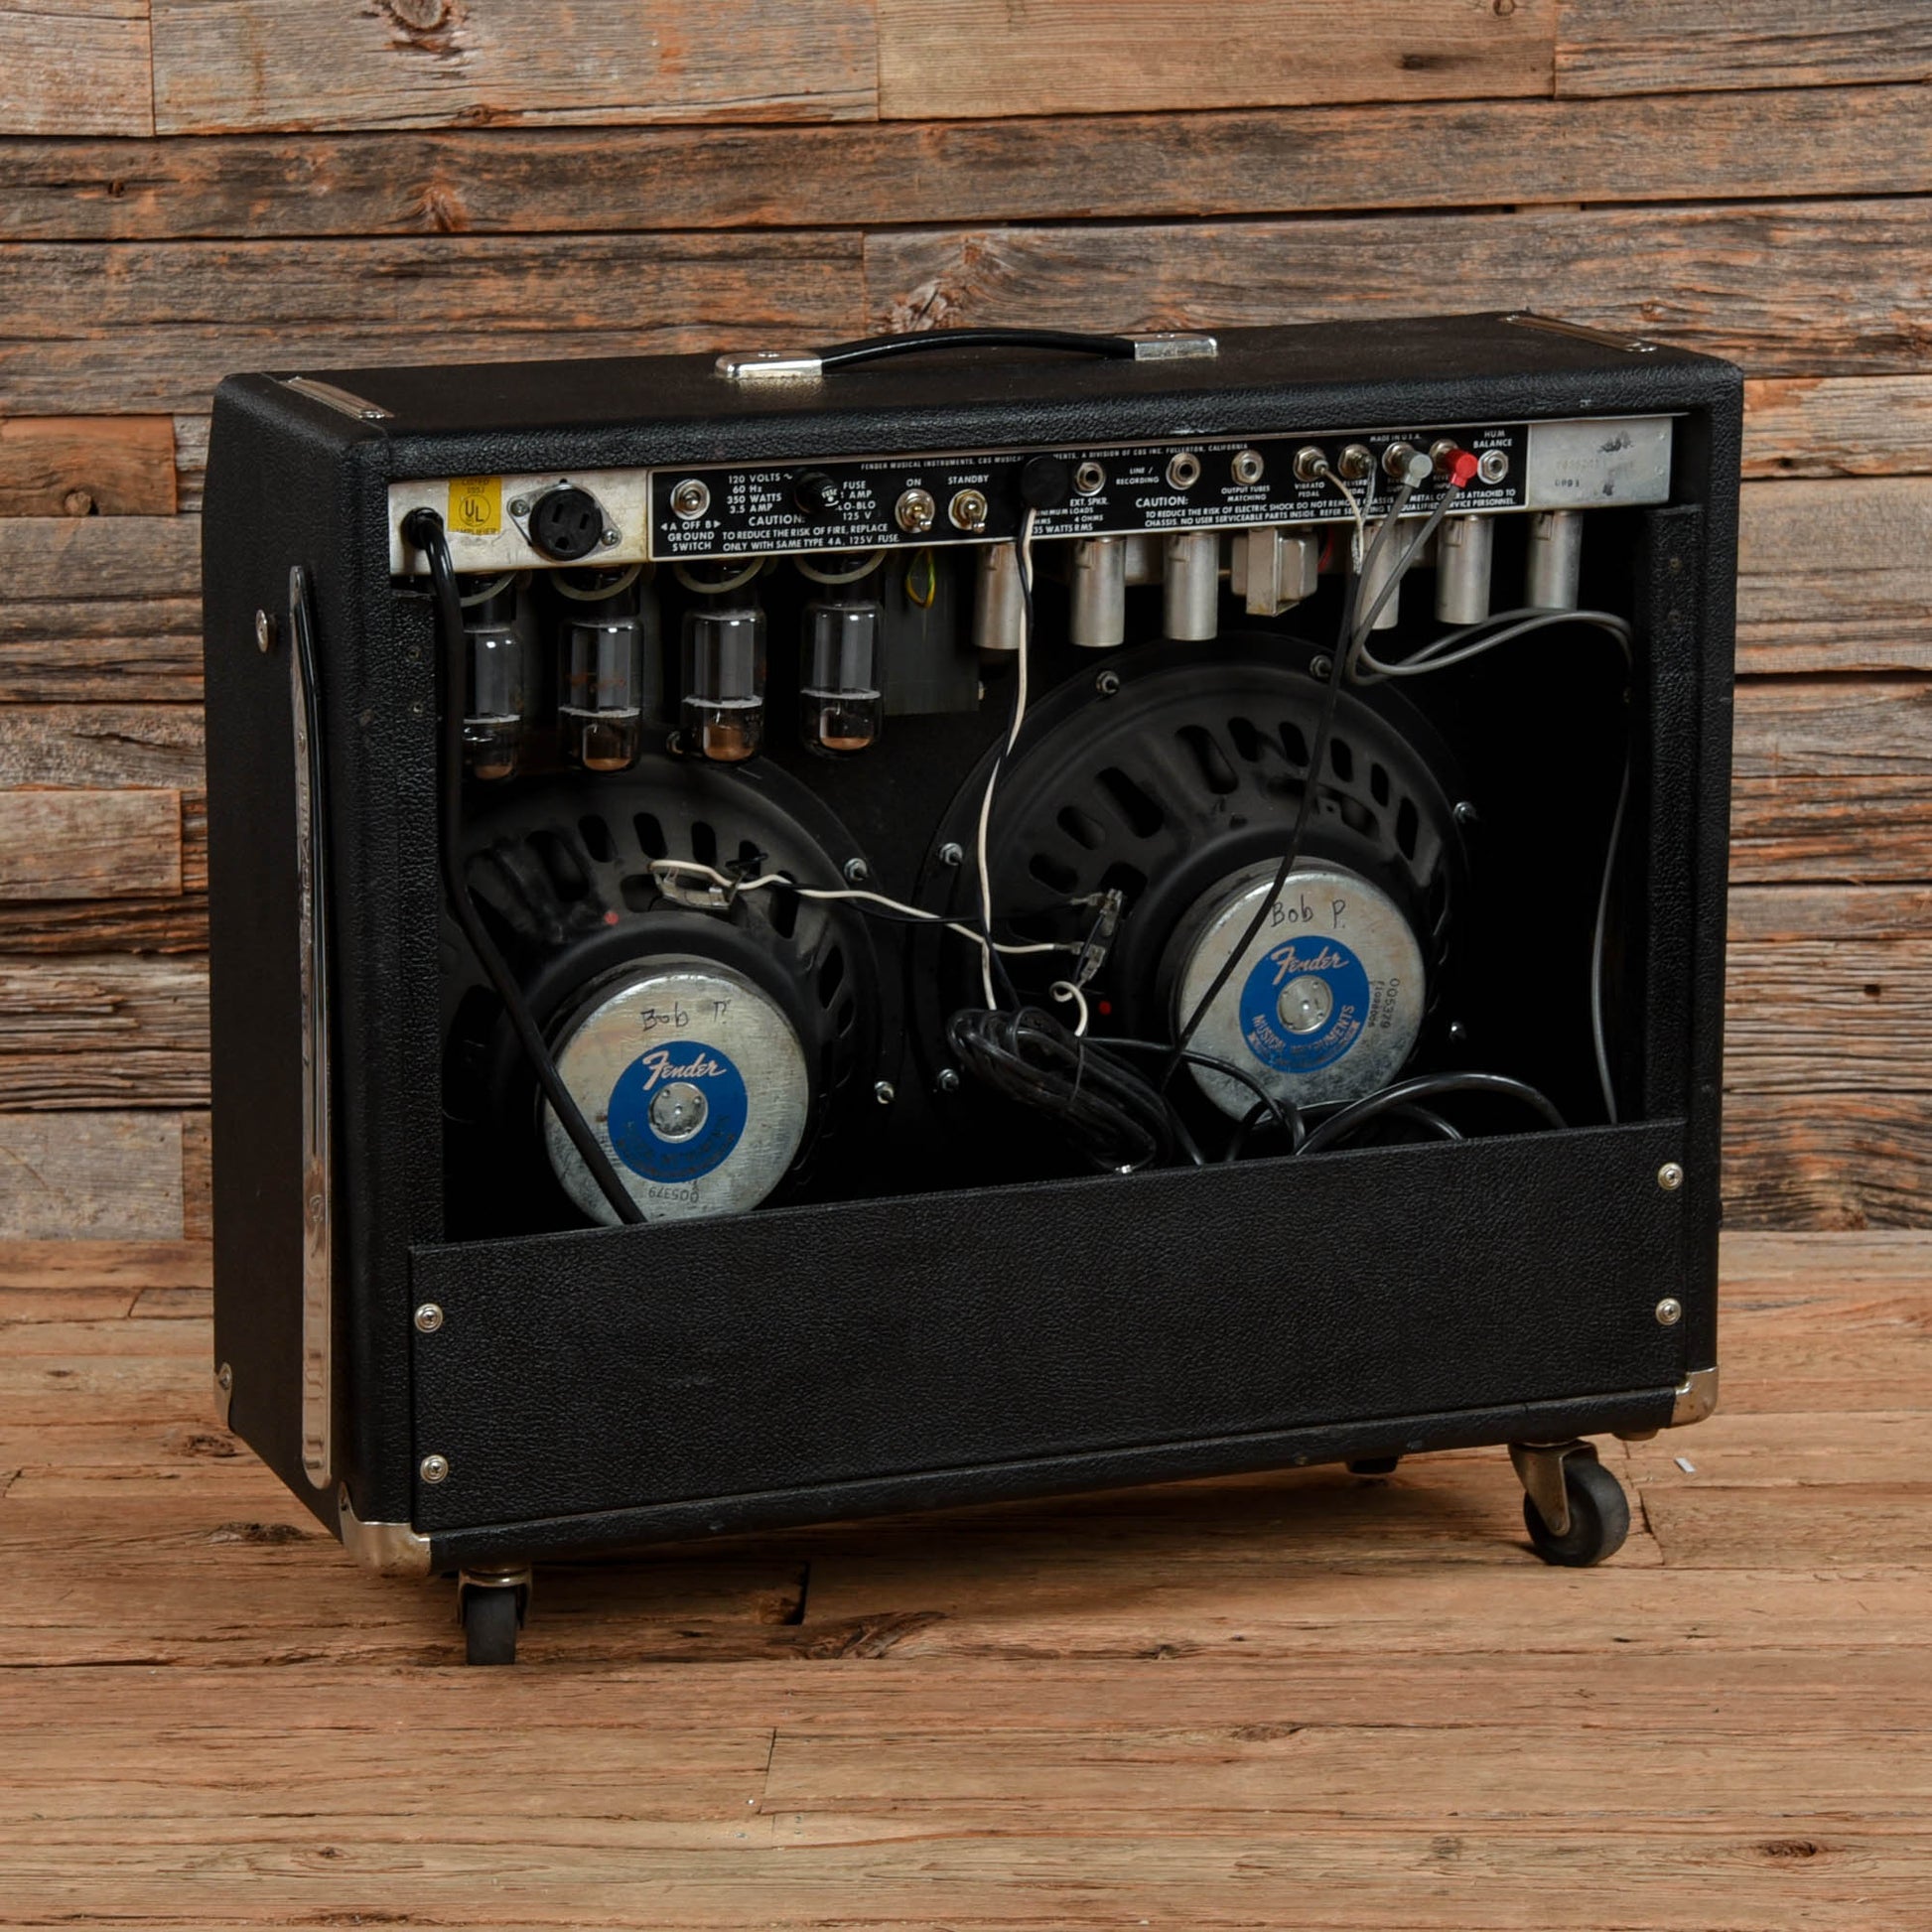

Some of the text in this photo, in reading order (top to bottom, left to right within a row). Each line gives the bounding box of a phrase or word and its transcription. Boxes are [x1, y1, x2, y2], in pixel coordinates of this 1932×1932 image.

[1208, 443, 1248, 452] CALIFORNIA
[1472, 439, 1512, 449] BALANCE
[861, 462, 887, 471] FENDER
[890, 460, 921, 469] MUSICAL
[729, 473, 780, 484] 120 VOLTS
[905, 479, 921, 487] ON
[947, 475, 989, 485] STANDBY
[1115, 476, 1160, 485] RECORDING
[733, 484, 762, 494] 60 Hz
[843, 481, 866, 489] FUSE
[1221, 484, 1271, 495] OUTPUT TUBES
[727, 493, 782, 504] 350 WATTS
[849, 489, 873, 499] AMP
[1227, 493, 1267, 502] MATCHING
[835, 500, 876, 511] LO-BLO
[1135, 495, 1188, 508] CAUTION:
[1146, 510, 1156, 519] TO
[1157, 508, 1186, 518] REDUCE
[1187, 507, 1201, 516] THE
[1202, 506, 1220, 515] RISK
[1222, 505, 1232, 514] OF
[1234, 504, 1267, 513] ELECTRIC
[1269, 502, 1294, 511] SHOCK
[1311, 499, 1326, 508] NOT
[1410, 493, 1434, 502] METAL
[1467, 489, 1504, 498] ATTACHED
[465, 499, 483, 522] UL
[730, 503, 773, 514] 3.5 AMP
[749, 514, 805, 527] CAUTION:
[843, 510, 872, 521] 125 V
[1180, 516, 1193, 525] NO
[1214, 512, 1264, 523] SERVICEABLE
[1265, 510, 1288, 519] PARTS
[1319, 507, 1341, 516] REFER
[669, 520, 712, 531] A OFF B
[1045, 524, 1072, 534] WATTS
[1074, 523, 1093, 532] RMS
[667, 531, 715, 542] GROUND
[723, 531, 735, 540] TO
[737, 530, 770, 540] REDUCE
[773, 529, 789, 538] THE
[790, 527, 810, 536] RISK
[813, 526, 825, 536] OF
[851, 523, 888, 533] REPLACE
[672, 541, 712, 552] SWITCH
[723, 542, 748, 552] ONLY
[751, 541, 773, 550] WITH
[776, 539, 801, 549] SAME
[804, 538, 823, 547] TYPE
[1270, 895, 1313, 927] Bob
[1271, 946, 1349, 986] Fender
[640, 1002, 689, 1032] Bob
[641, 1050, 727, 1091] Fender
[648, 1185, 700, 1203] 005379
